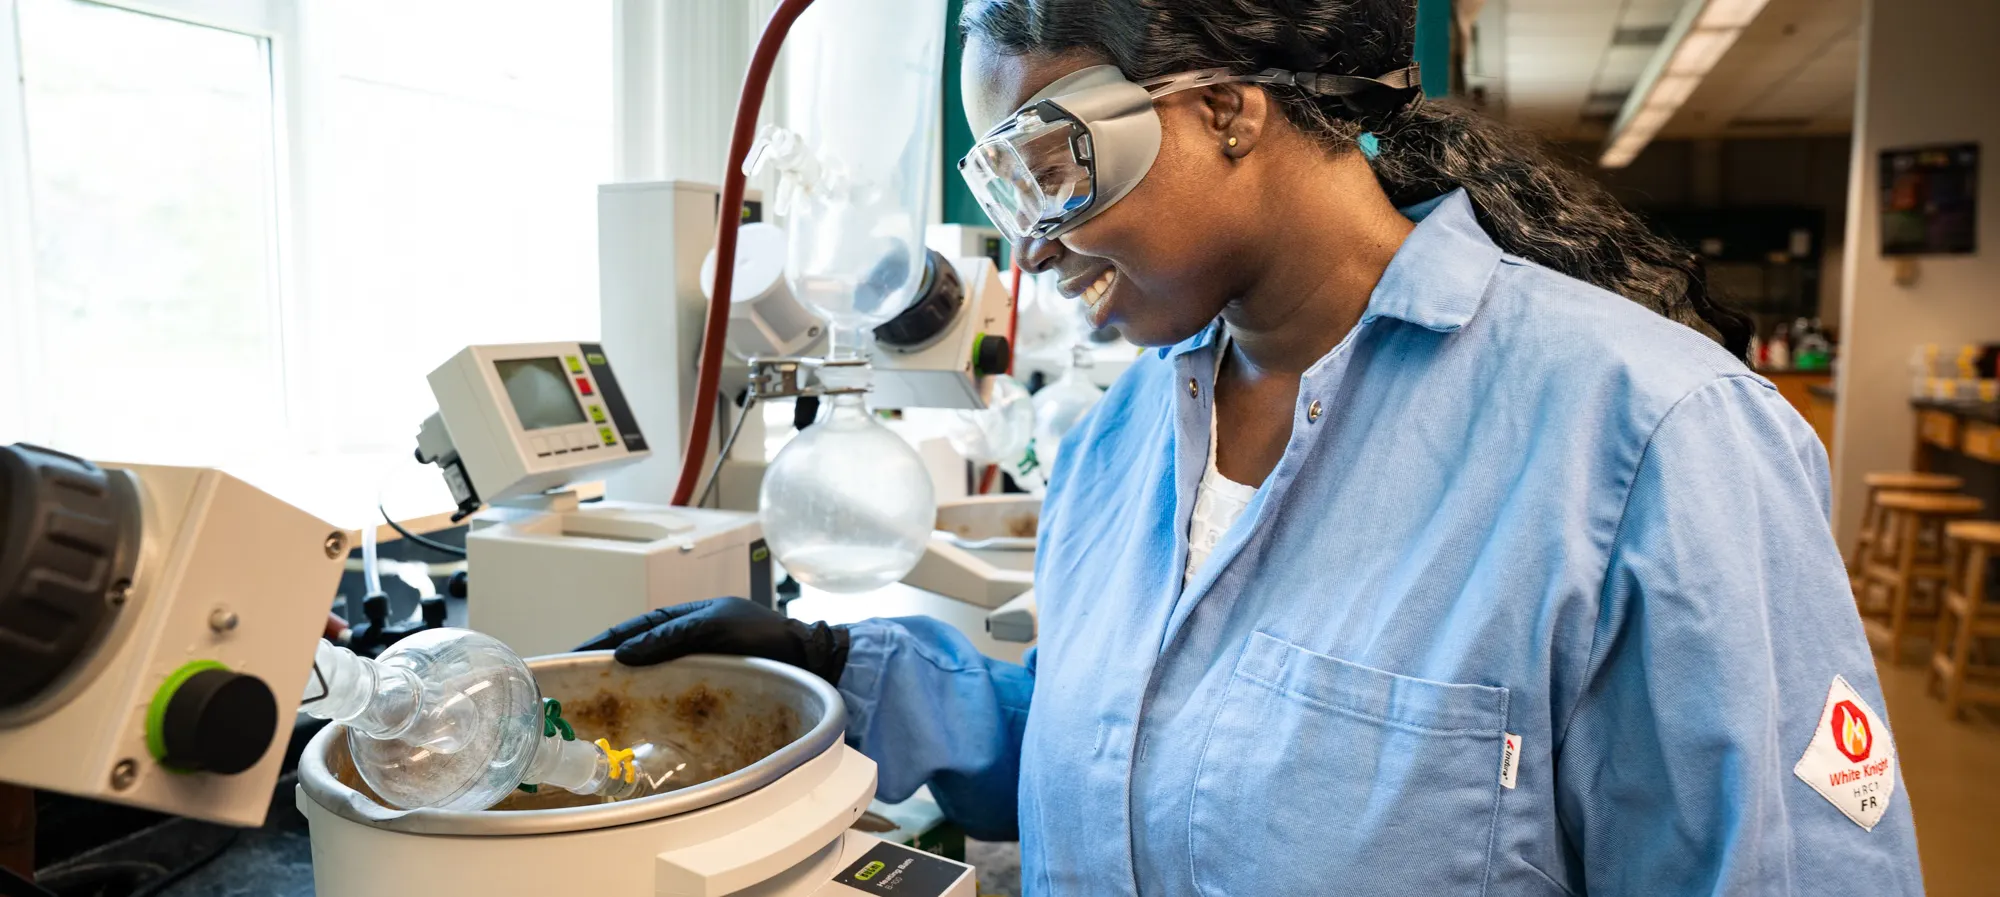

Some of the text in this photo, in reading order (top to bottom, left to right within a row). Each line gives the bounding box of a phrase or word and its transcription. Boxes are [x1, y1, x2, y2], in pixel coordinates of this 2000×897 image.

[1829, 758, 1888, 786] White Knight
[1861, 796, 1877, 811] FR
[876, 858, 914, 887] Heating Bath
